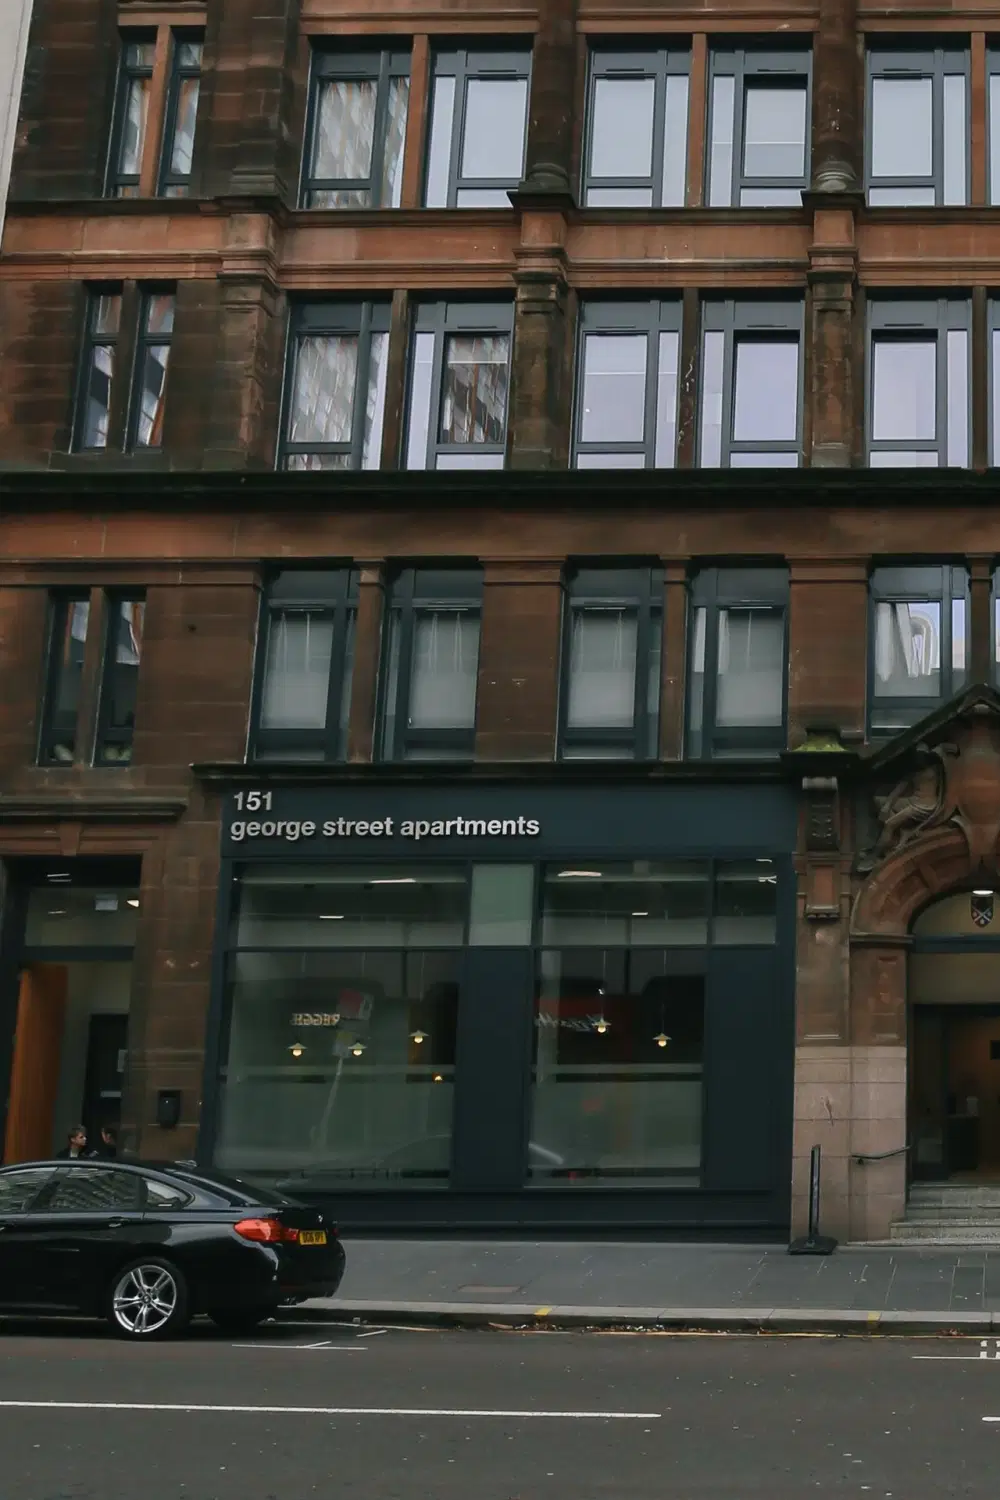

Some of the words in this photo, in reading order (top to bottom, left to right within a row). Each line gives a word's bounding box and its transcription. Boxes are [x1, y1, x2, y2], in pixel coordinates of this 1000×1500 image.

[233, 791, 272, 811] 151
[230, 820, 316, 841] george
[322, 817, 394, 836] street
[400, 816, 540, 840] apartments
